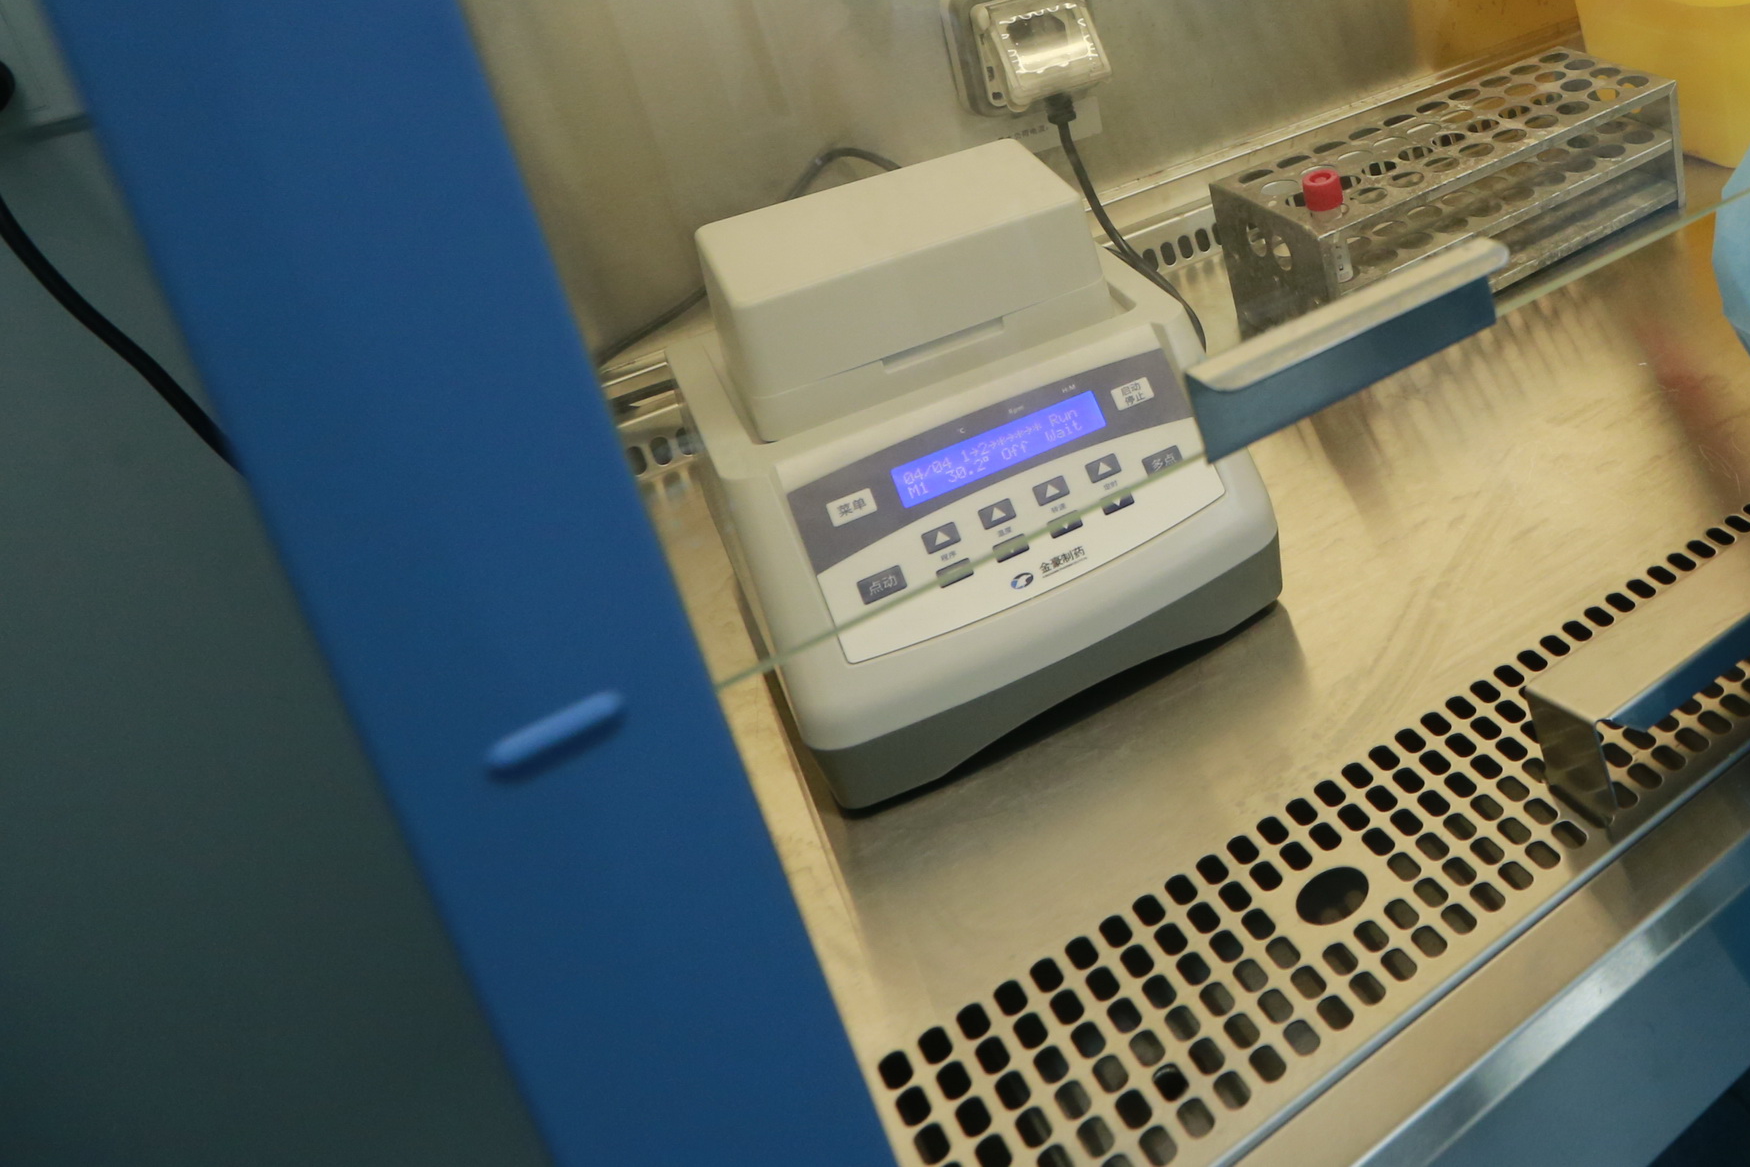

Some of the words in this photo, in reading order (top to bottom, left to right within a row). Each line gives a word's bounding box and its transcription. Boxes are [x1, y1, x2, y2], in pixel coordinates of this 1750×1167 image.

[1120, 382, 1141, 397] 启动
[1124, 392, 1146, 407] 停止
[904, 457, 952, 485] 04/04
[1048, 409, 1079, 427] Run
[907, 482, 930, 499] M1
[1001, 441, 1029, 461] Off
[1044, 425, 1083, 442] Wait
[1151, 452, 1177, 472] 多点
[836, 497, 868, 518] 菜单
[1039, 545, 1086, 574] 金豪制药
[868, 575, 898, 596] 点动
